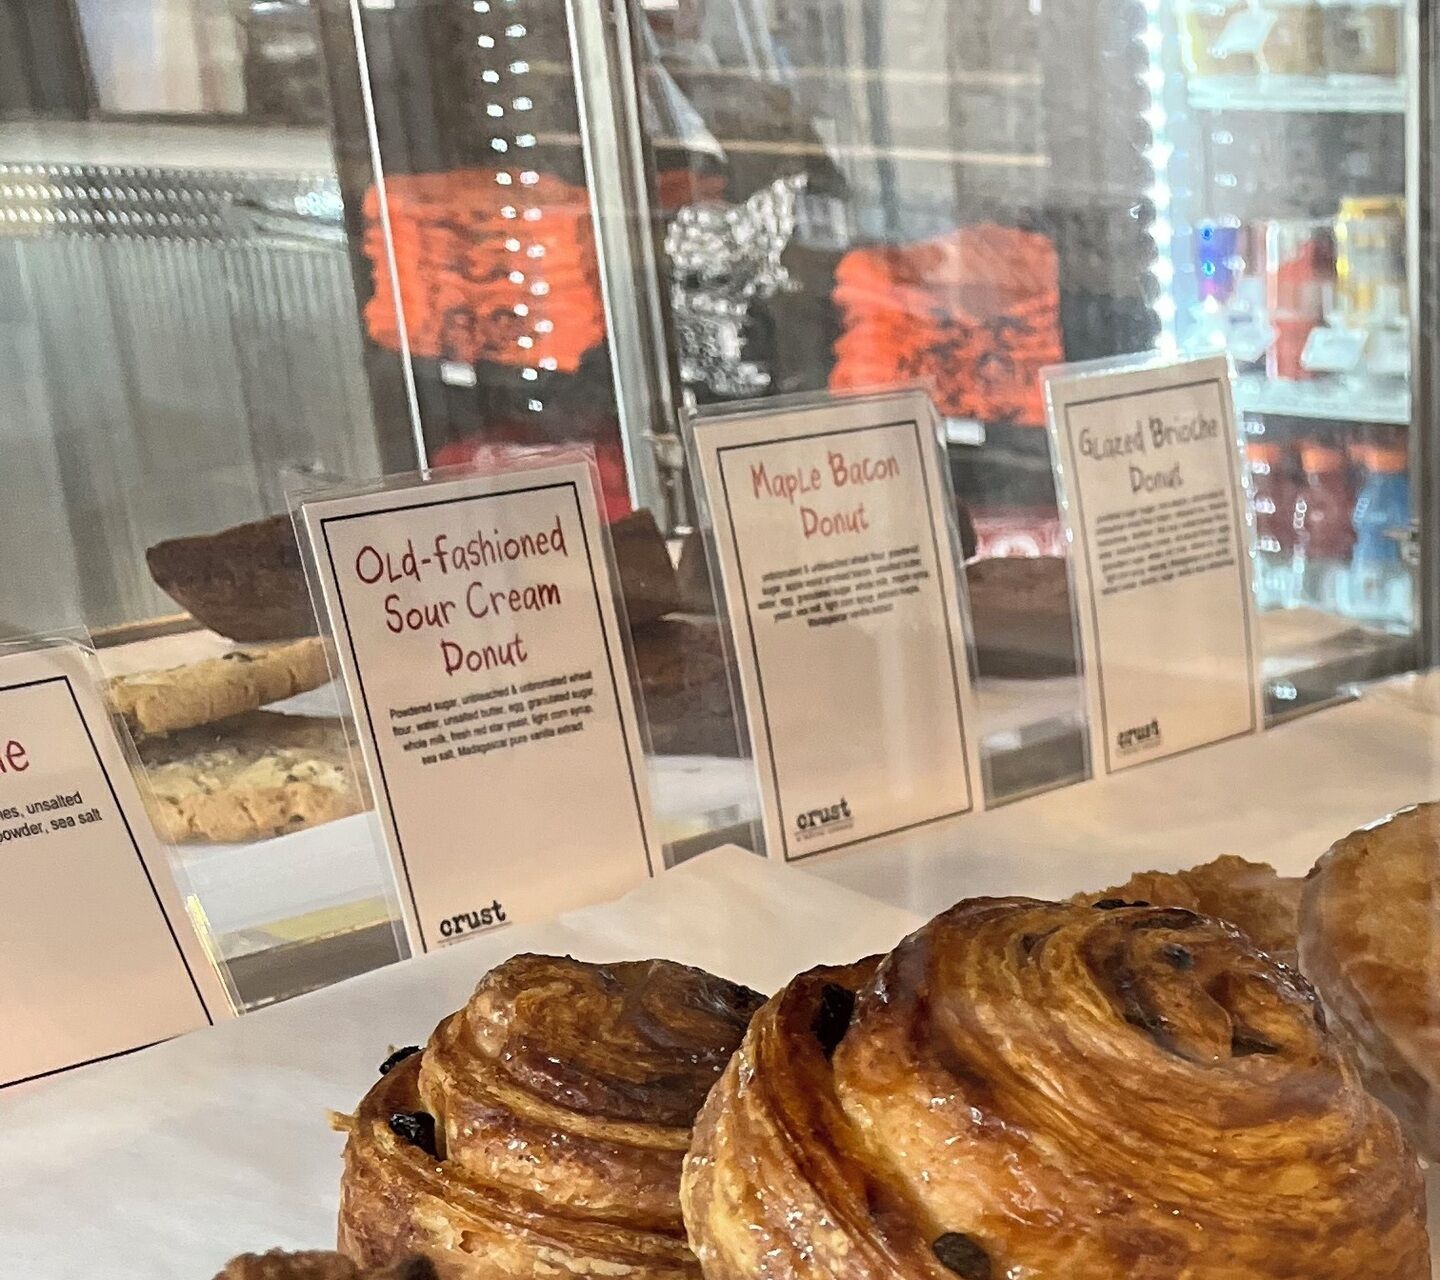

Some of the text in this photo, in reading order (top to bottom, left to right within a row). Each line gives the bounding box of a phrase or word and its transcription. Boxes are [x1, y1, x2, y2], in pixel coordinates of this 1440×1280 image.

[750, 450, 899, 504] Maple Bacon
[800, 504, 869, 540] Donut
[384, 580, 562, 634] Sour Cream
[440, 633, 529, 677] Donut
[389, 702, 432, 718] Powdered
[26, 791, 83, 815] unsalted
[50, 815, 76, 831] sea
[78, 808, 103, 825] salt
[796, 795, 851, 829] crust
[440, 899, 507, 937] crust
